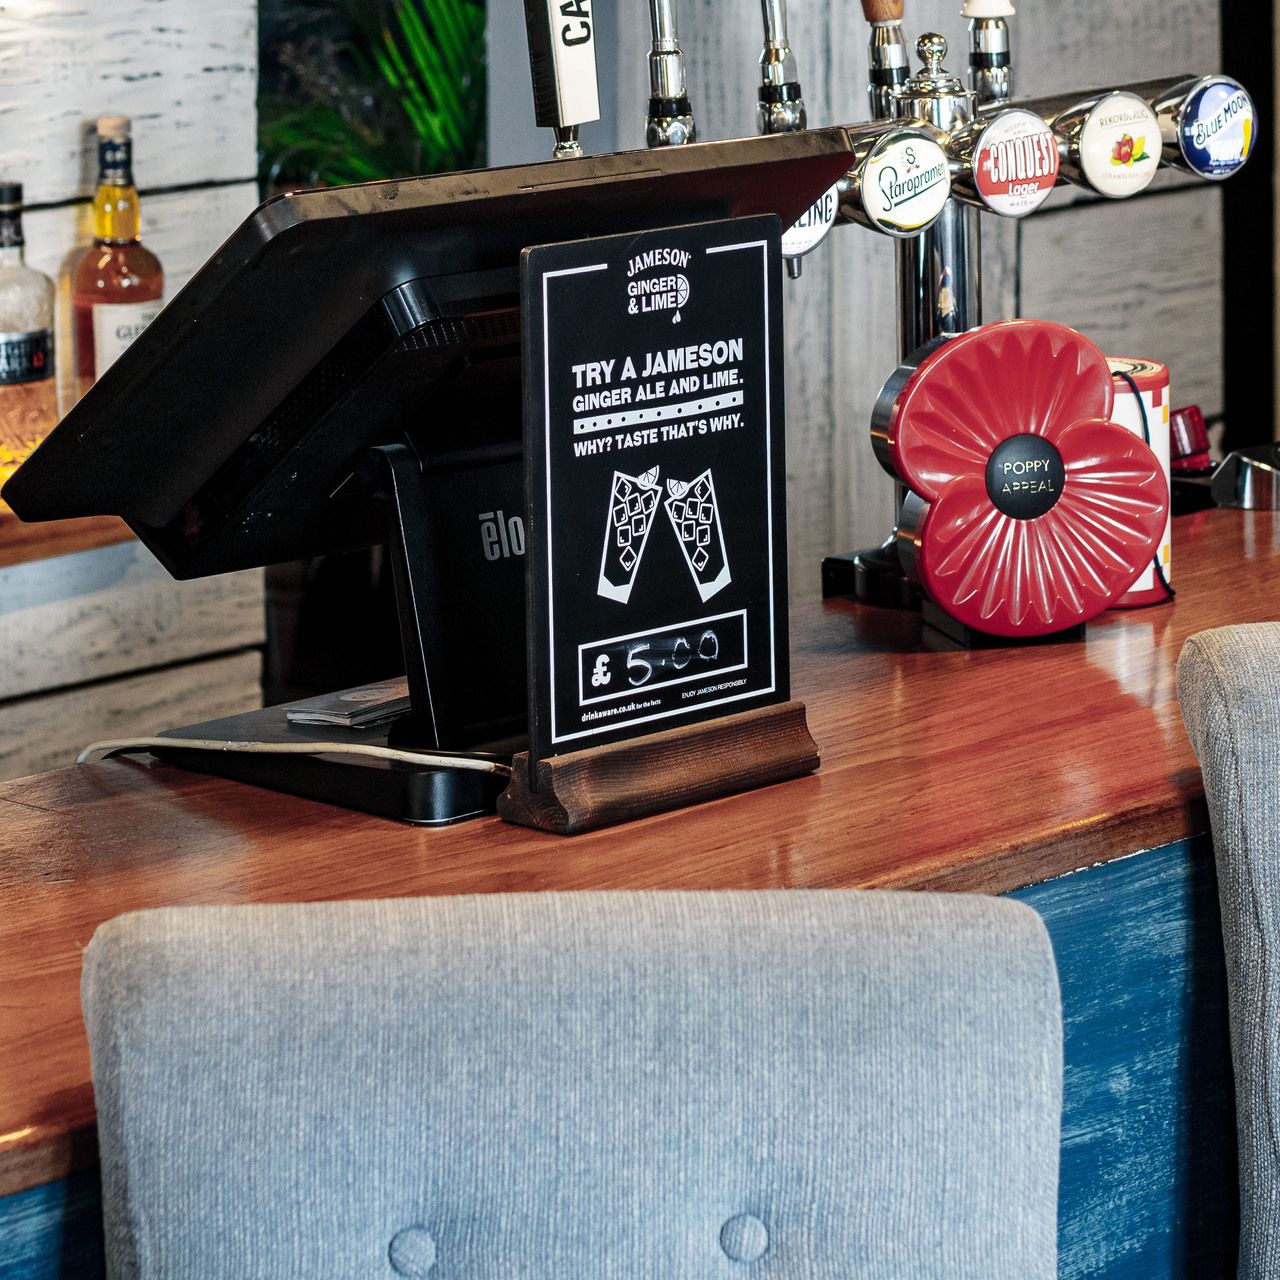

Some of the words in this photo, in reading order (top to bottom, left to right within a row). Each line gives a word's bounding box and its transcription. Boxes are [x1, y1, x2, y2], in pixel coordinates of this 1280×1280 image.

[1195, 117, 1223, 145] BLUE
[1223, 96, 1250, 120] MOON
[989, 131, 1058, 183] CONQUEST
[878, 161, 946, 212] Staropramen
[1008, 181, 1040, 197] Lager
[627, 248, 689, 276] JAMESON
[627, 277, 677, 296] GINGER
[628, 297, 639, 314] &
[642, 291, 677, 312] LIME
[572, 359, 616, 389] TRY
[621, 356, 637, 381] A
[641, 338, 744, 376] JAMESON
[572, 387, 632, 413] GINGER
[635, 381, 665, 402] ALE
[669, 376, 700, 396] AND
[703, 369, 744, 390] LIME.
[574, 436, 612, 457] WHY?
[616, 428, 658, 450] TASTE
[661, 420, 708, 441] THAT'S
[710, 413, 744, 433] WHY.
[1003, 459, 1050, 475] POPPY
[1002, 480, 1054, 495] APPEAL
[591, 654, 611, 687] £
[681, 690, 696, 699] ENJOY
[696, 686, 717, 696] JAMESON
[581, 702, 636, 722] drinkaware.co.uk
